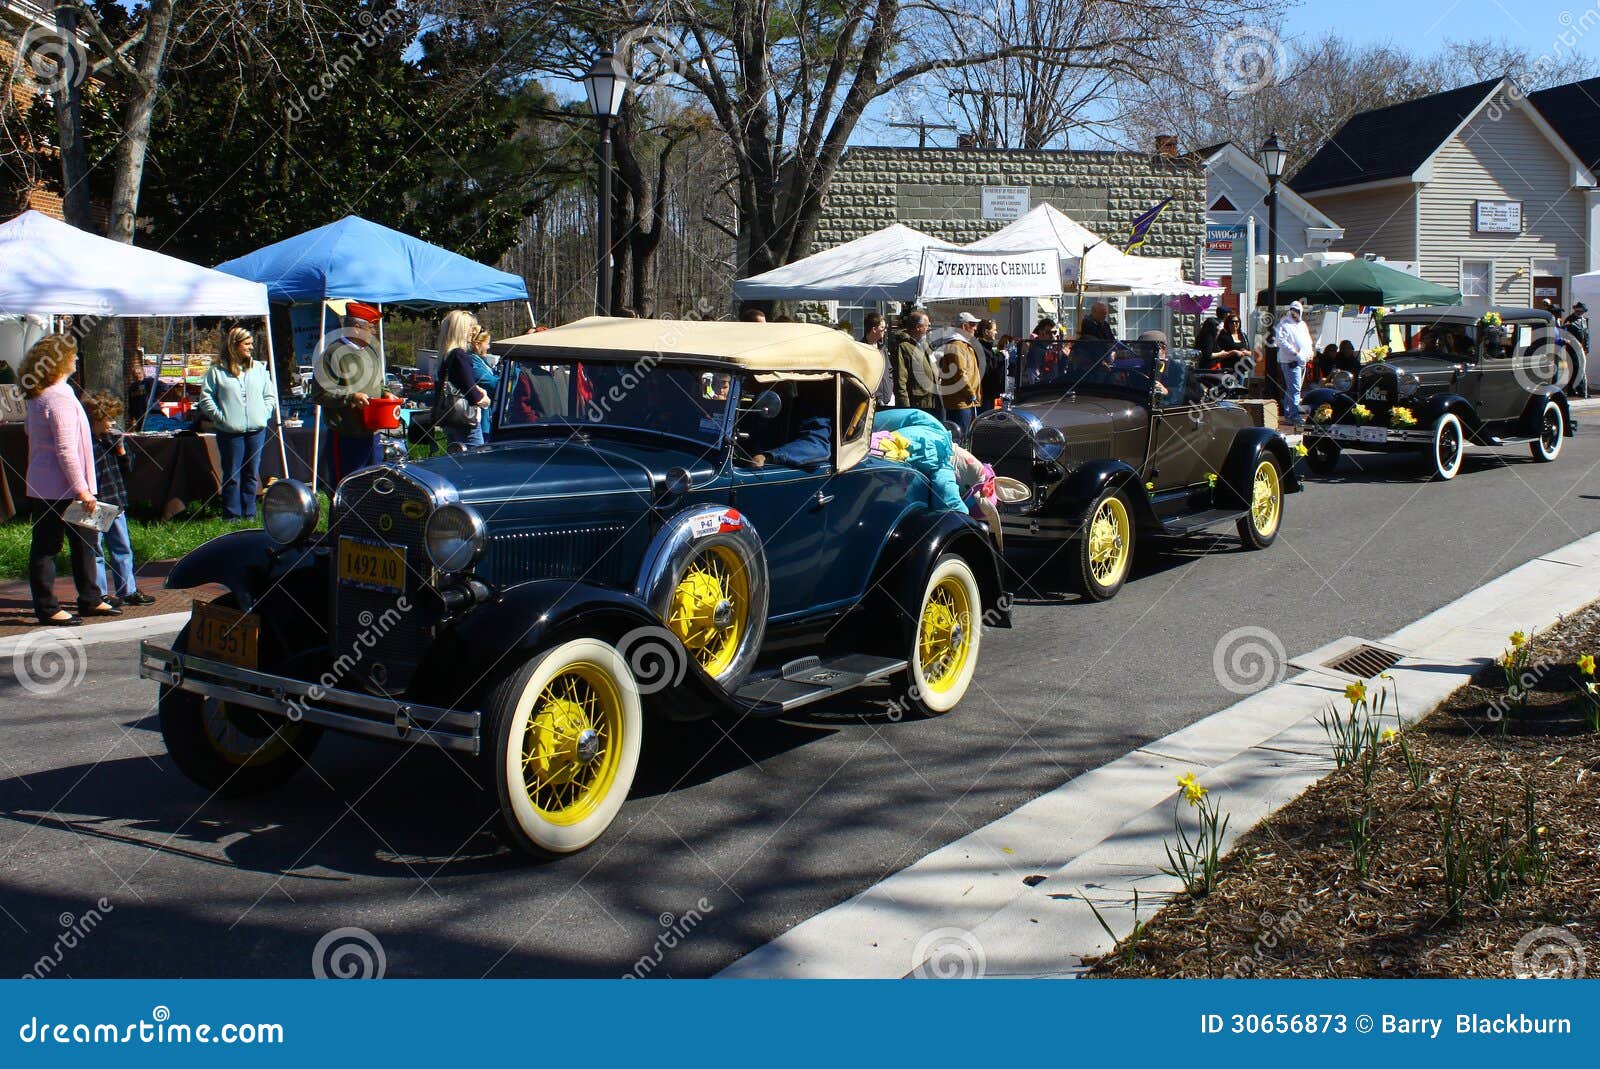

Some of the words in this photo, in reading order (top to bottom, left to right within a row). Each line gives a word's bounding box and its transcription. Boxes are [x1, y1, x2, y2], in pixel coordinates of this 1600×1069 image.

[936, 260, 999, 276] EVERYTHING
[1000, 261, 1047, 276] CHENILLE
[346, 553, 377, 577] 1492
